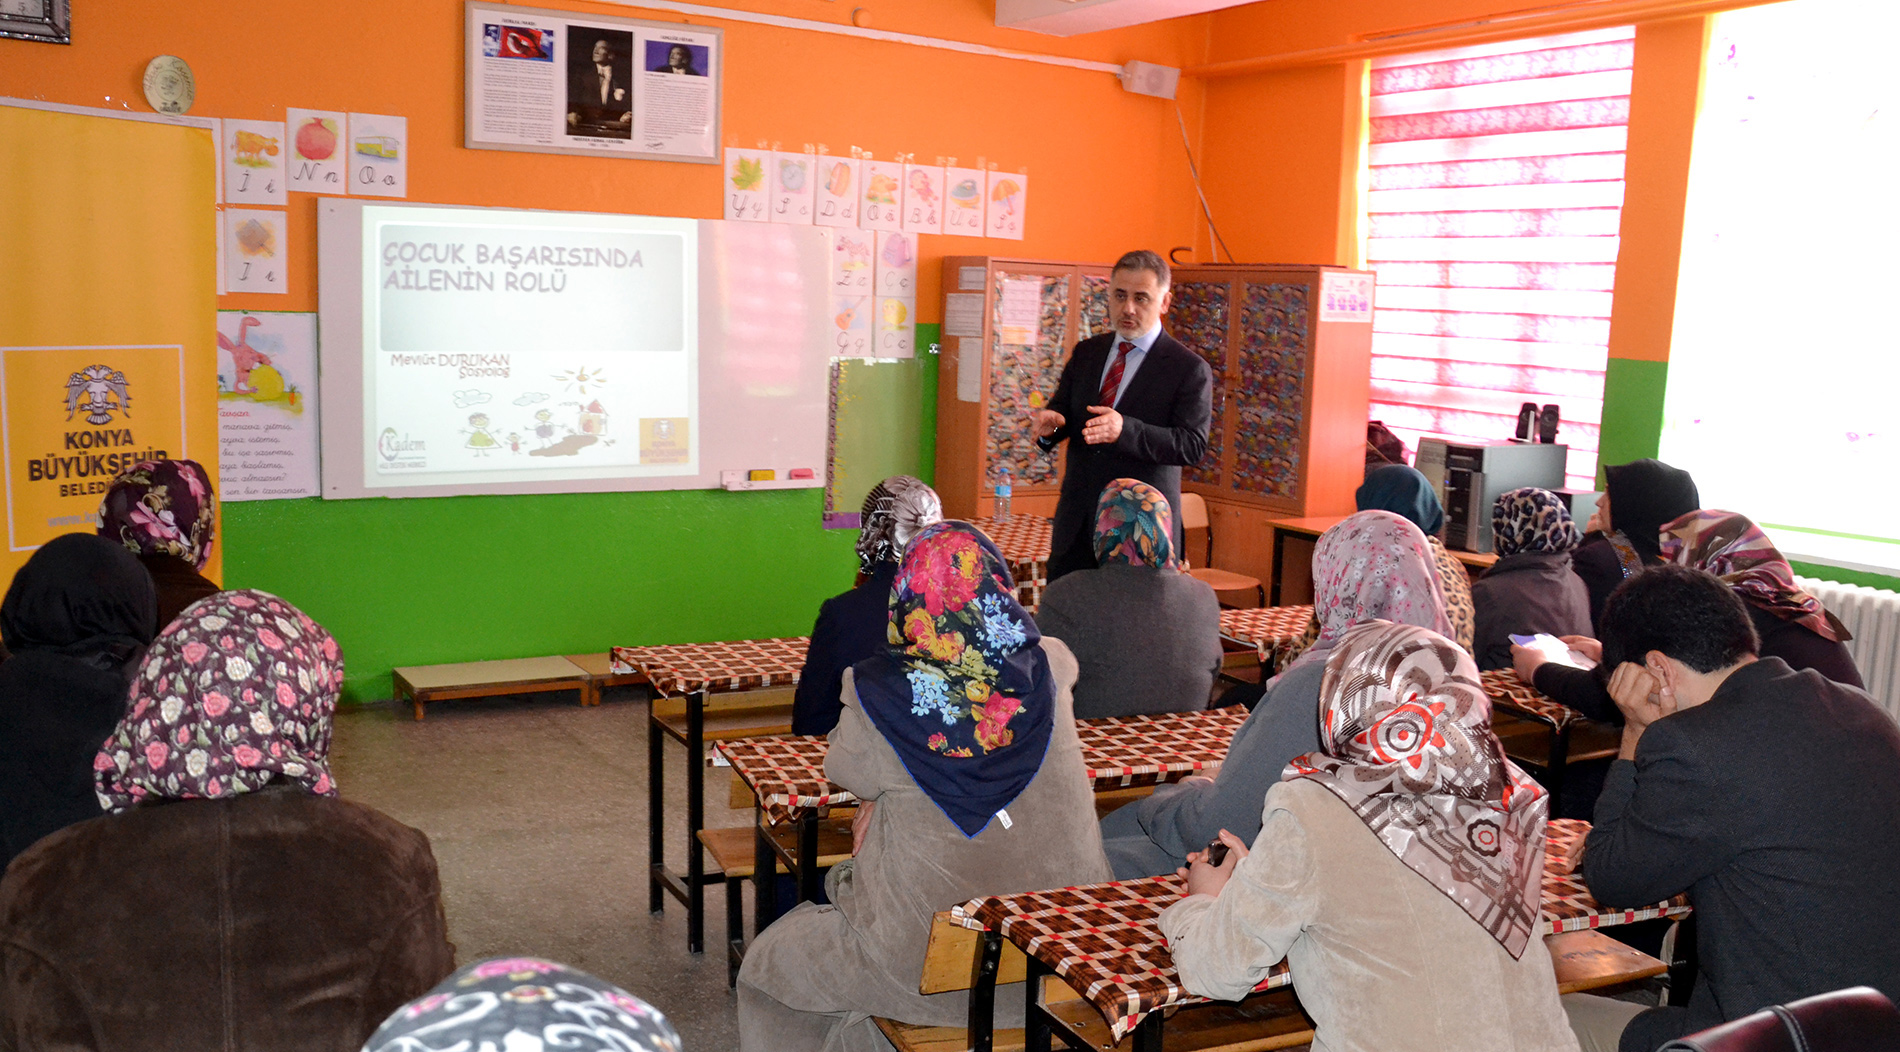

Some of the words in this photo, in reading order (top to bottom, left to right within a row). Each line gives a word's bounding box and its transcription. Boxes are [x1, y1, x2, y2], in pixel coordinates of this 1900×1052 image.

[293, 162, 321, 181] N
[324, 171, 339, 183] n
[359, 165, 374, 185] O
[732, 194, 749, 218] Y
[751, 202, 762, 219] y
[820, 200, 836, 217] D
[841, 202, 854, 218] d
[908, 207, 922, 224] B
[383, 241, 465, 267] ÇOCUK
[476, 243, 644, 270] BAŞARISINDA
[383, 264, 494, 292] AİLENİN
[505, 268, 567, 293] ROLÜ
[836, 269, 851, 286] Z
[391, 353, 436, 367] Mevlüt
[438, 353, 510, 367] DURUKAN
[459, 366, 510, 379] Sosyolog
[64, 429, 134, 450] KONYA
[385, 432, 426, 452] Kadem
[59, 478, 112, 497] BELEDİ
